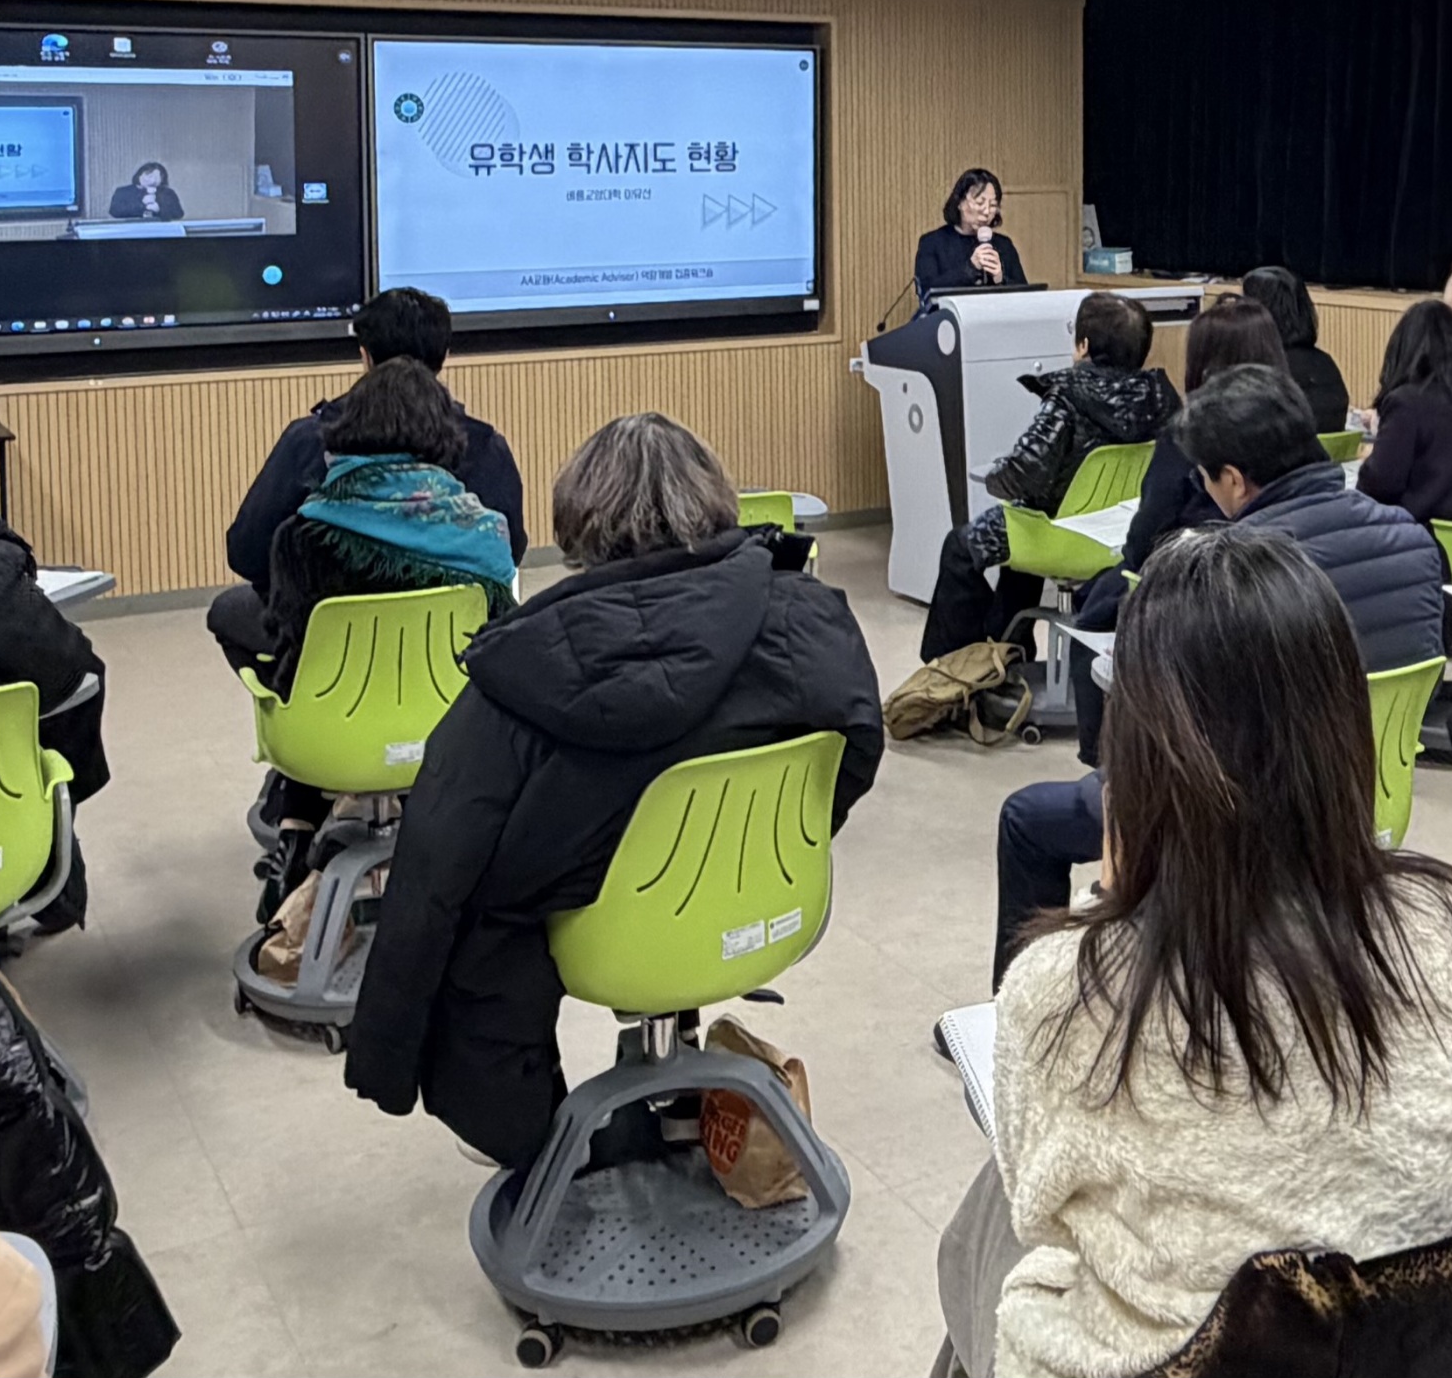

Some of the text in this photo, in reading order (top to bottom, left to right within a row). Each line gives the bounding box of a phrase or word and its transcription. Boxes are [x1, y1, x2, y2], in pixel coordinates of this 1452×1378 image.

[468, 141, 739, 175] 유학생 학사지도 현황
